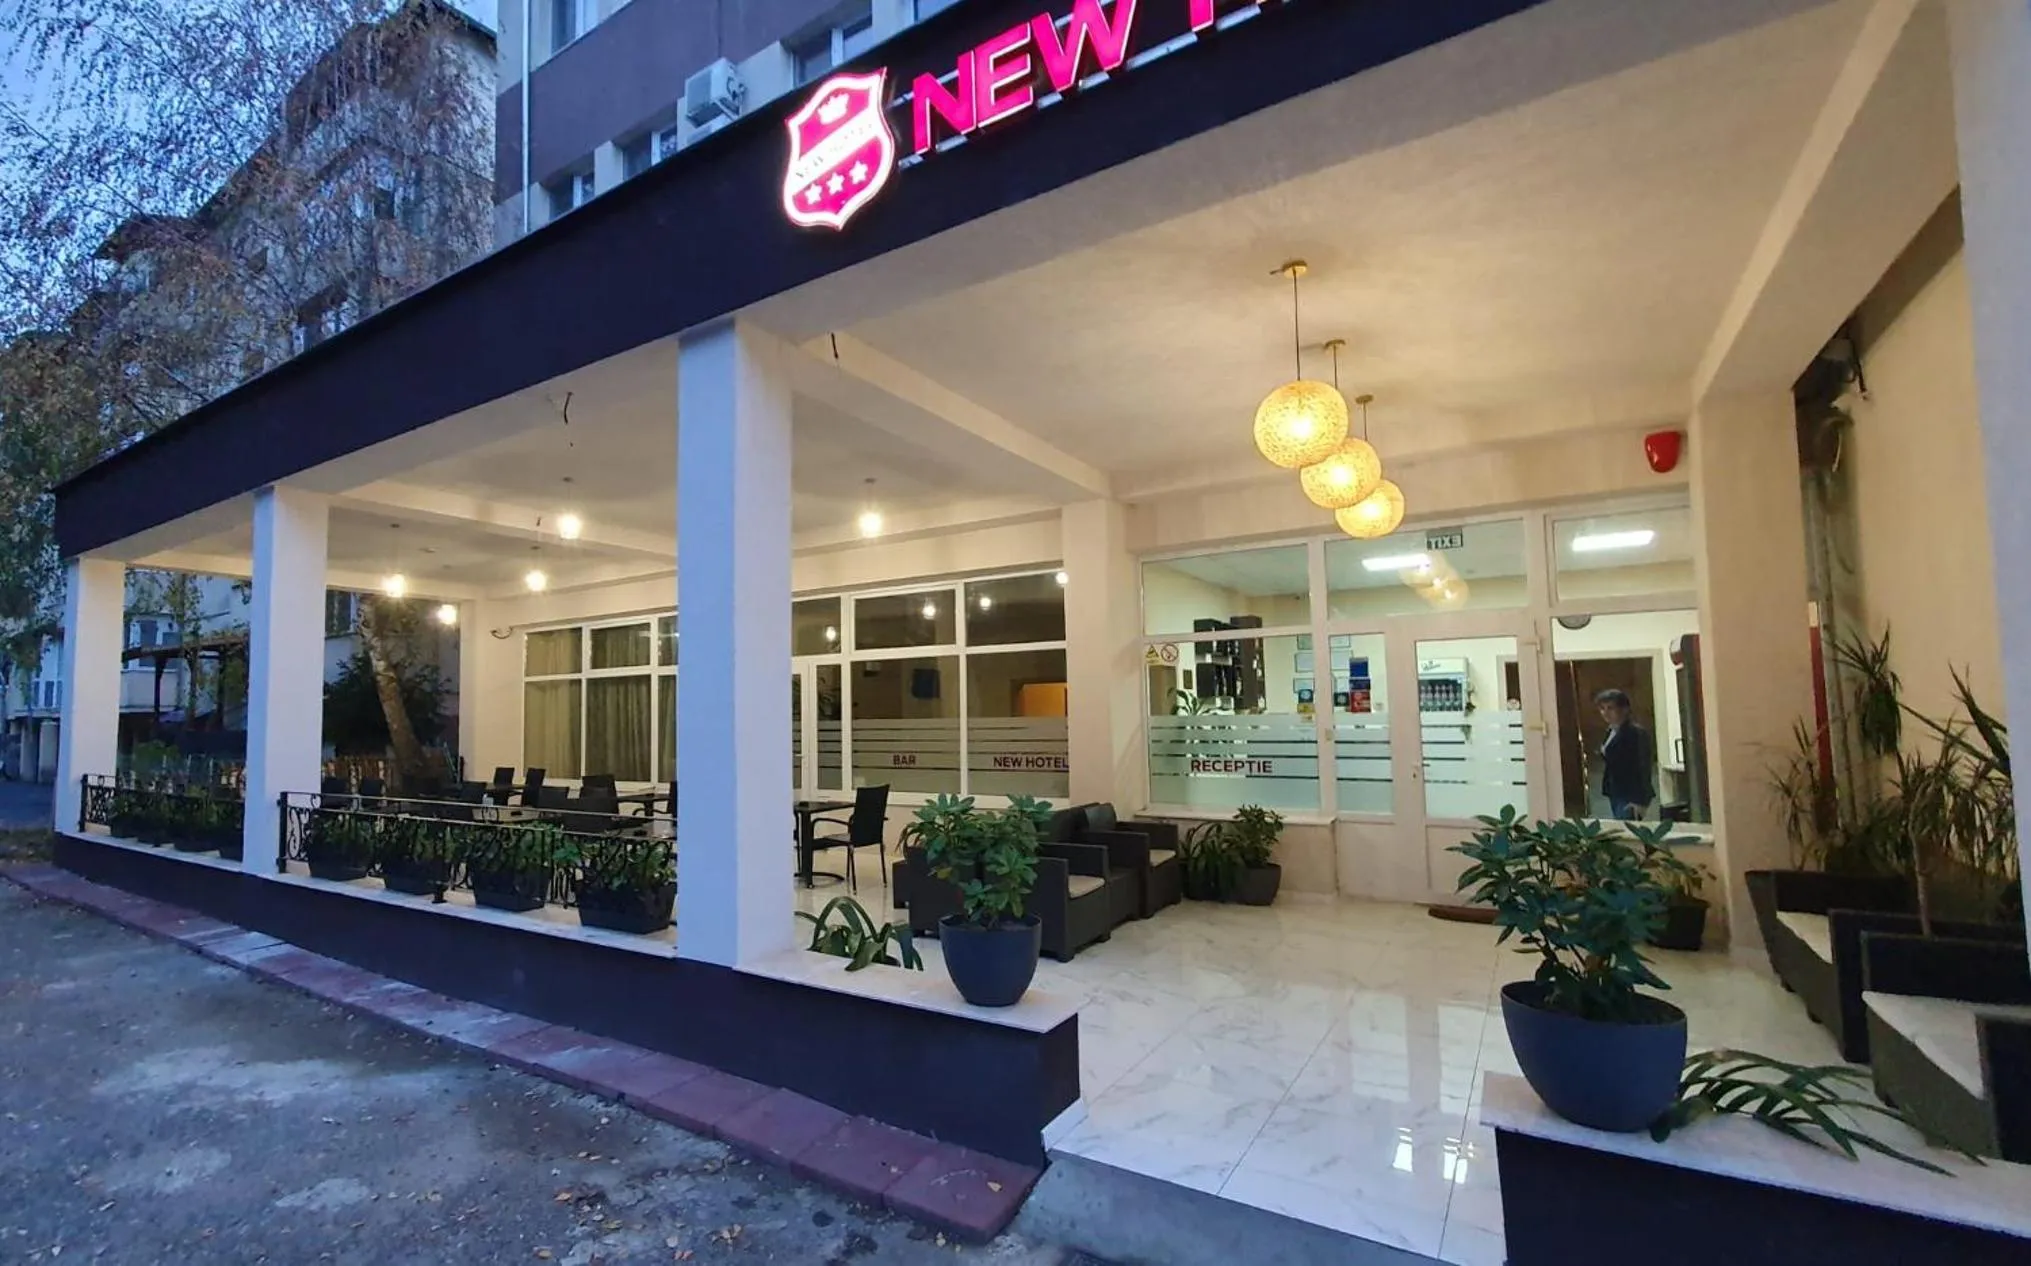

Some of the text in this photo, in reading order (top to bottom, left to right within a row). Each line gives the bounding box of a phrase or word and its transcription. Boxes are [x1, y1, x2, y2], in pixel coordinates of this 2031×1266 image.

[913, 0, 1135, 154] NEW
[893, 755, 916, 765] BAR
[993, 757, 1069, 768] NEW HOTEL
